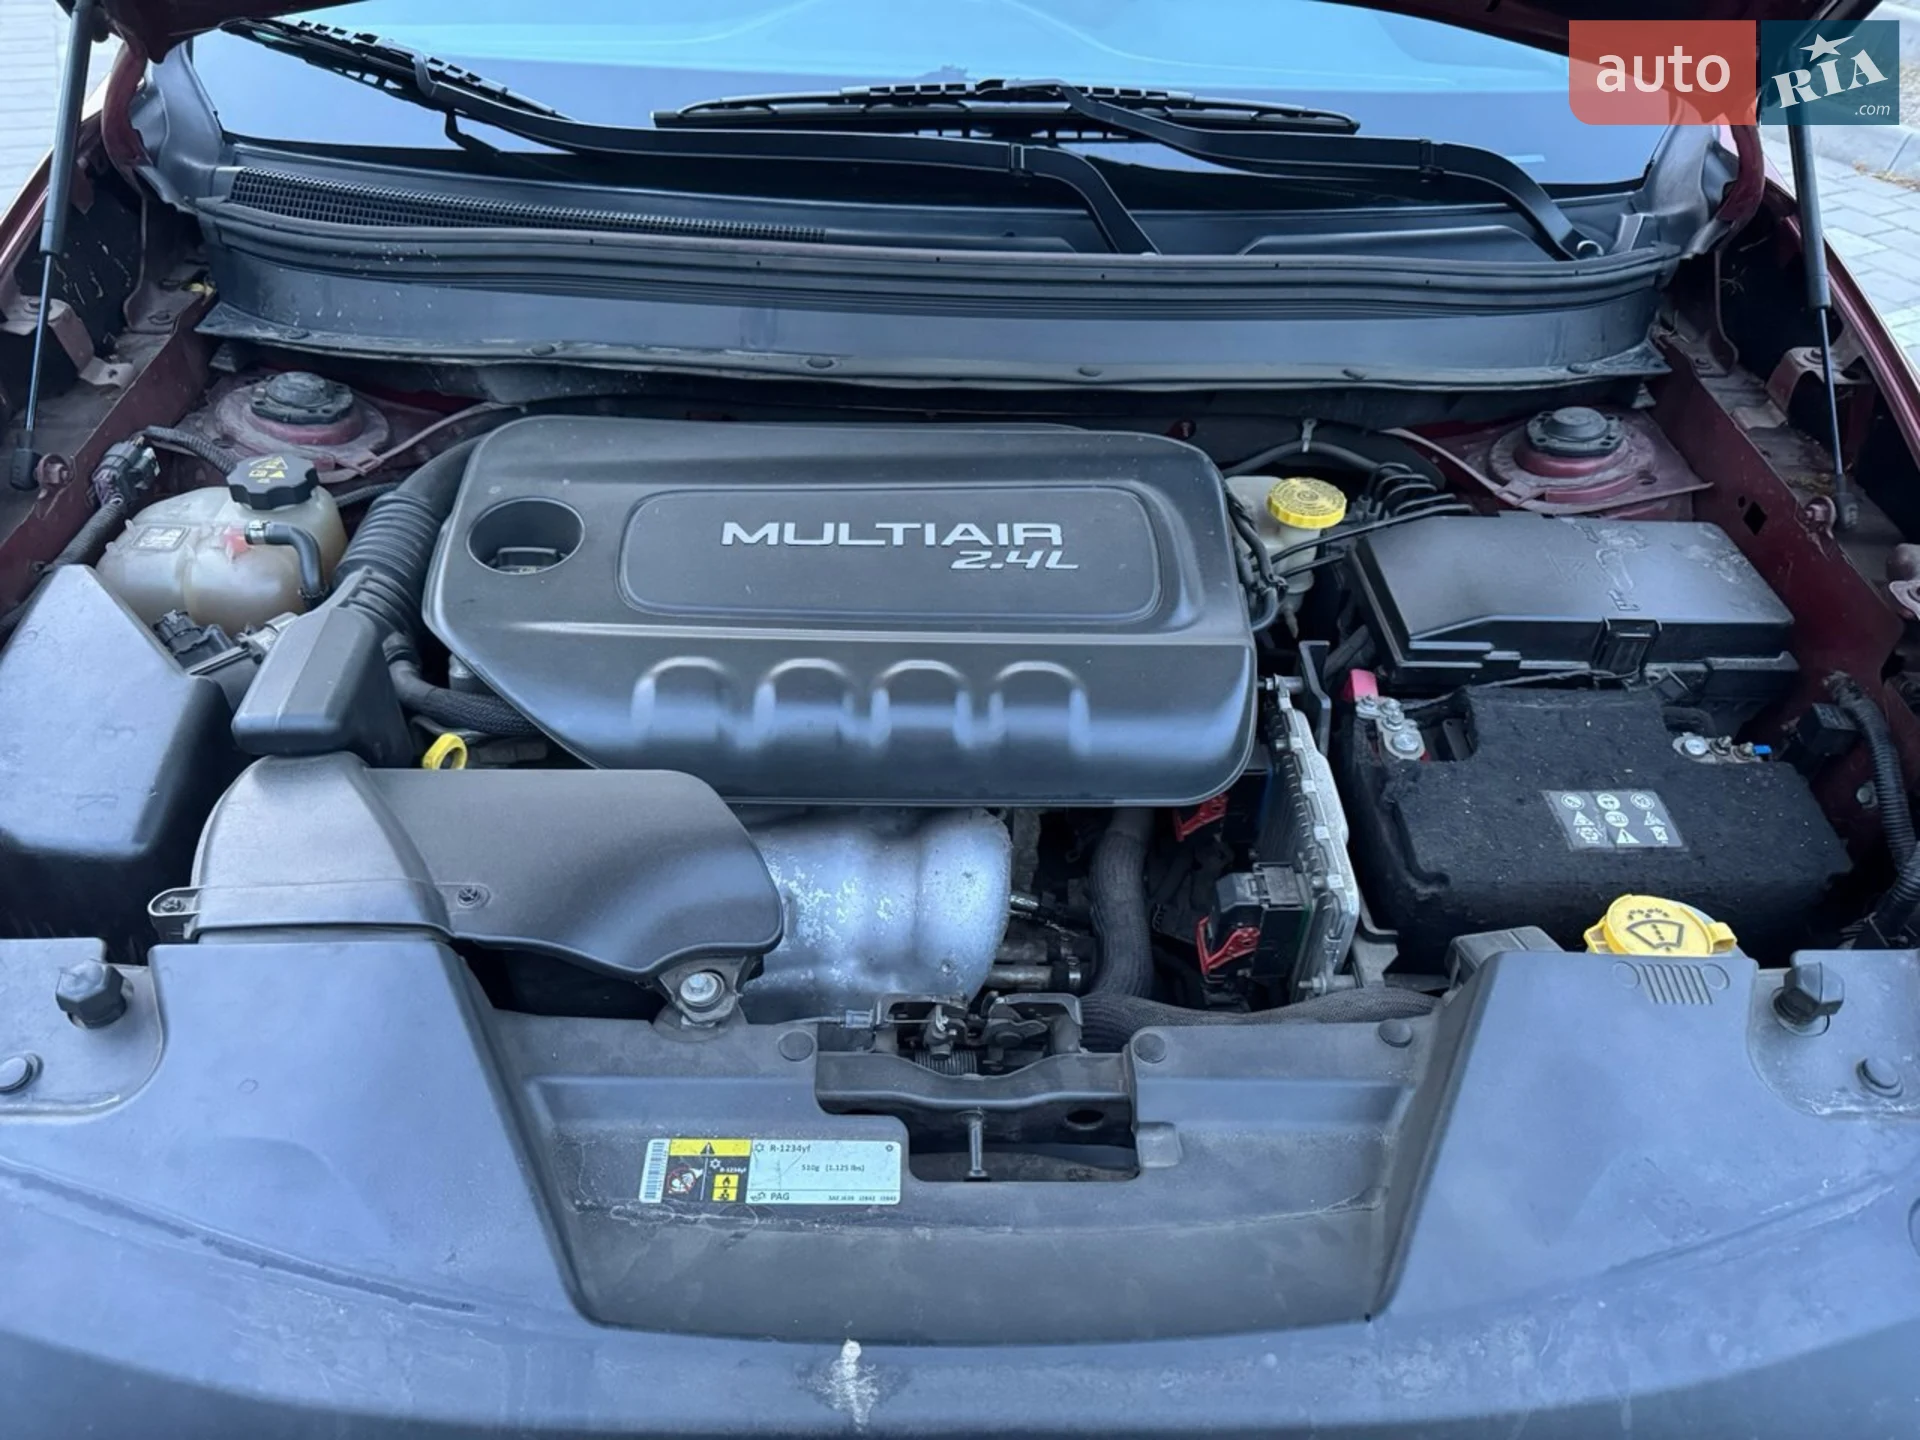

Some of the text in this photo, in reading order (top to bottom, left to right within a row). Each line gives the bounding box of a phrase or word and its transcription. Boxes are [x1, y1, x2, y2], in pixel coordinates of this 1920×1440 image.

[721, 522, 1063, 546] MULTIAIR
[950, 550, 1079, 570] 2.4L
[769, 1143, 811, 1153] R-1234yf
[770, 1192, 790, 1201] PAG
